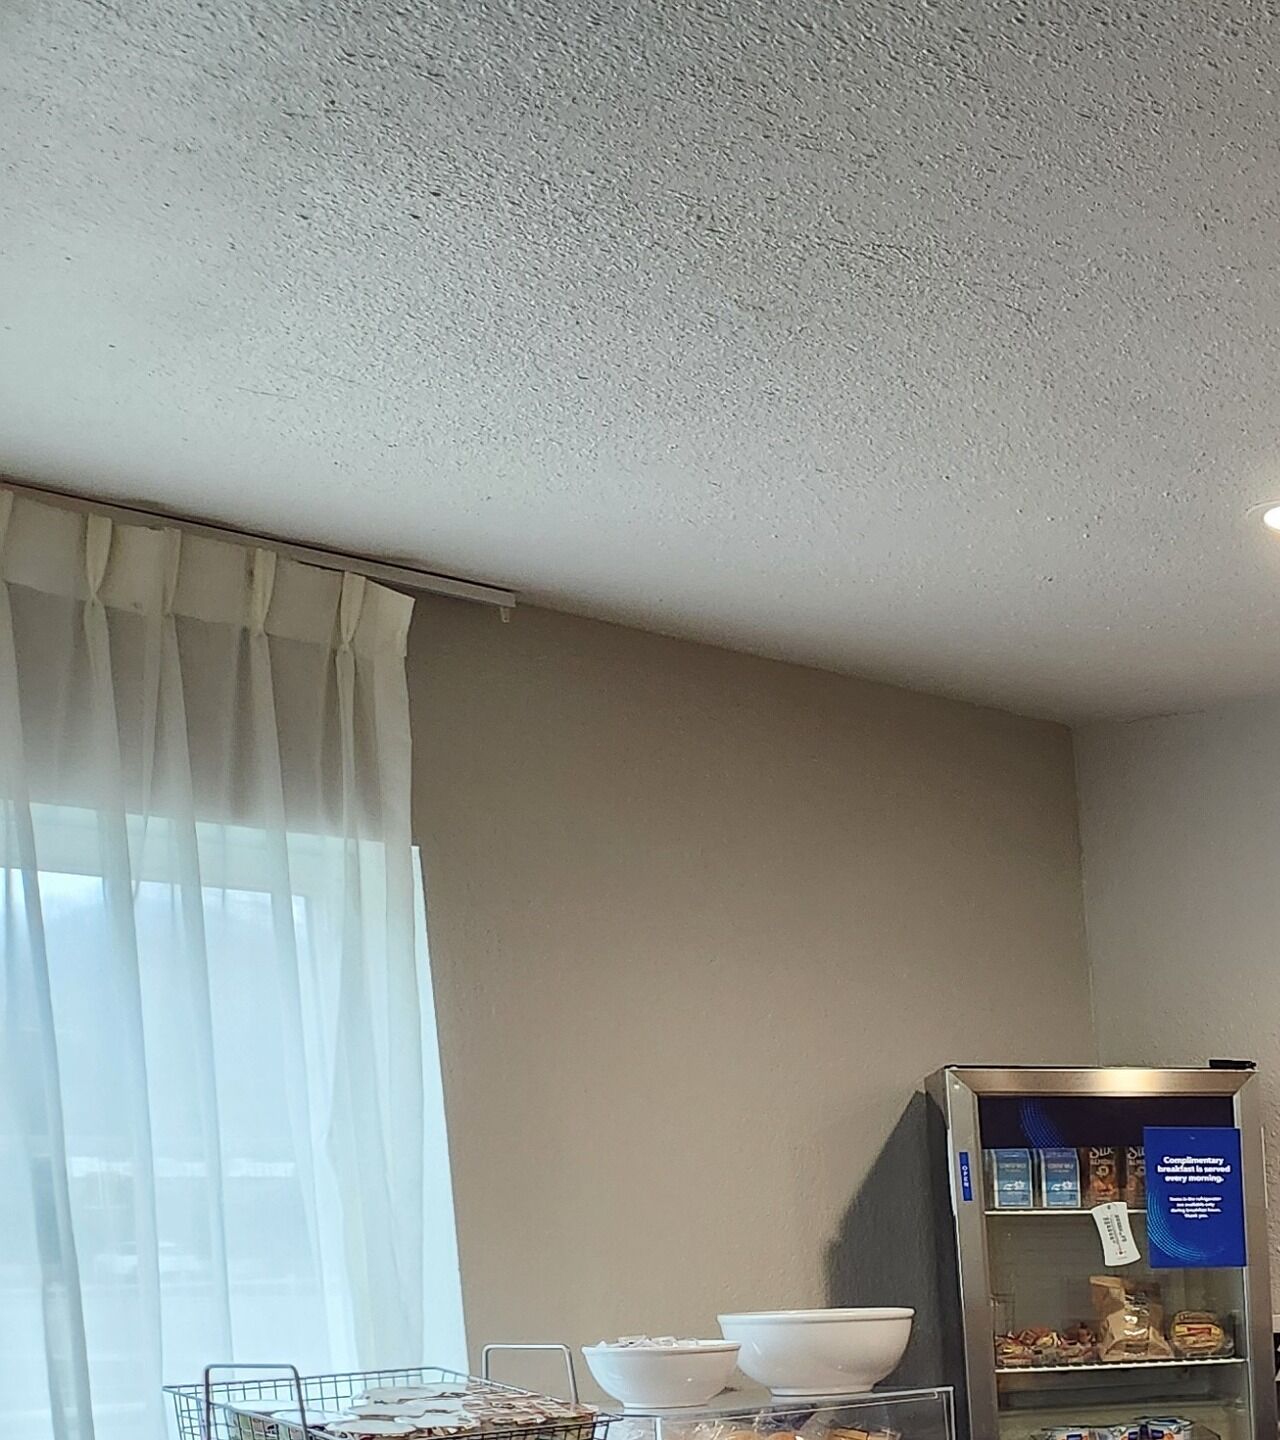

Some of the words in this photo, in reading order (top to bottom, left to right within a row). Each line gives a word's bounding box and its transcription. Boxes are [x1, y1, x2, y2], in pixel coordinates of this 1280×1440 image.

[1163, 1156, 1224, 1165] Complimentary
[1157, 1165, 1195, 1173] breakfast
[1196, 1165, 1203, 1173] is
[1204, 1165, 1231, 1173] served
[1189, 1174, 1224, 1184] morning.
